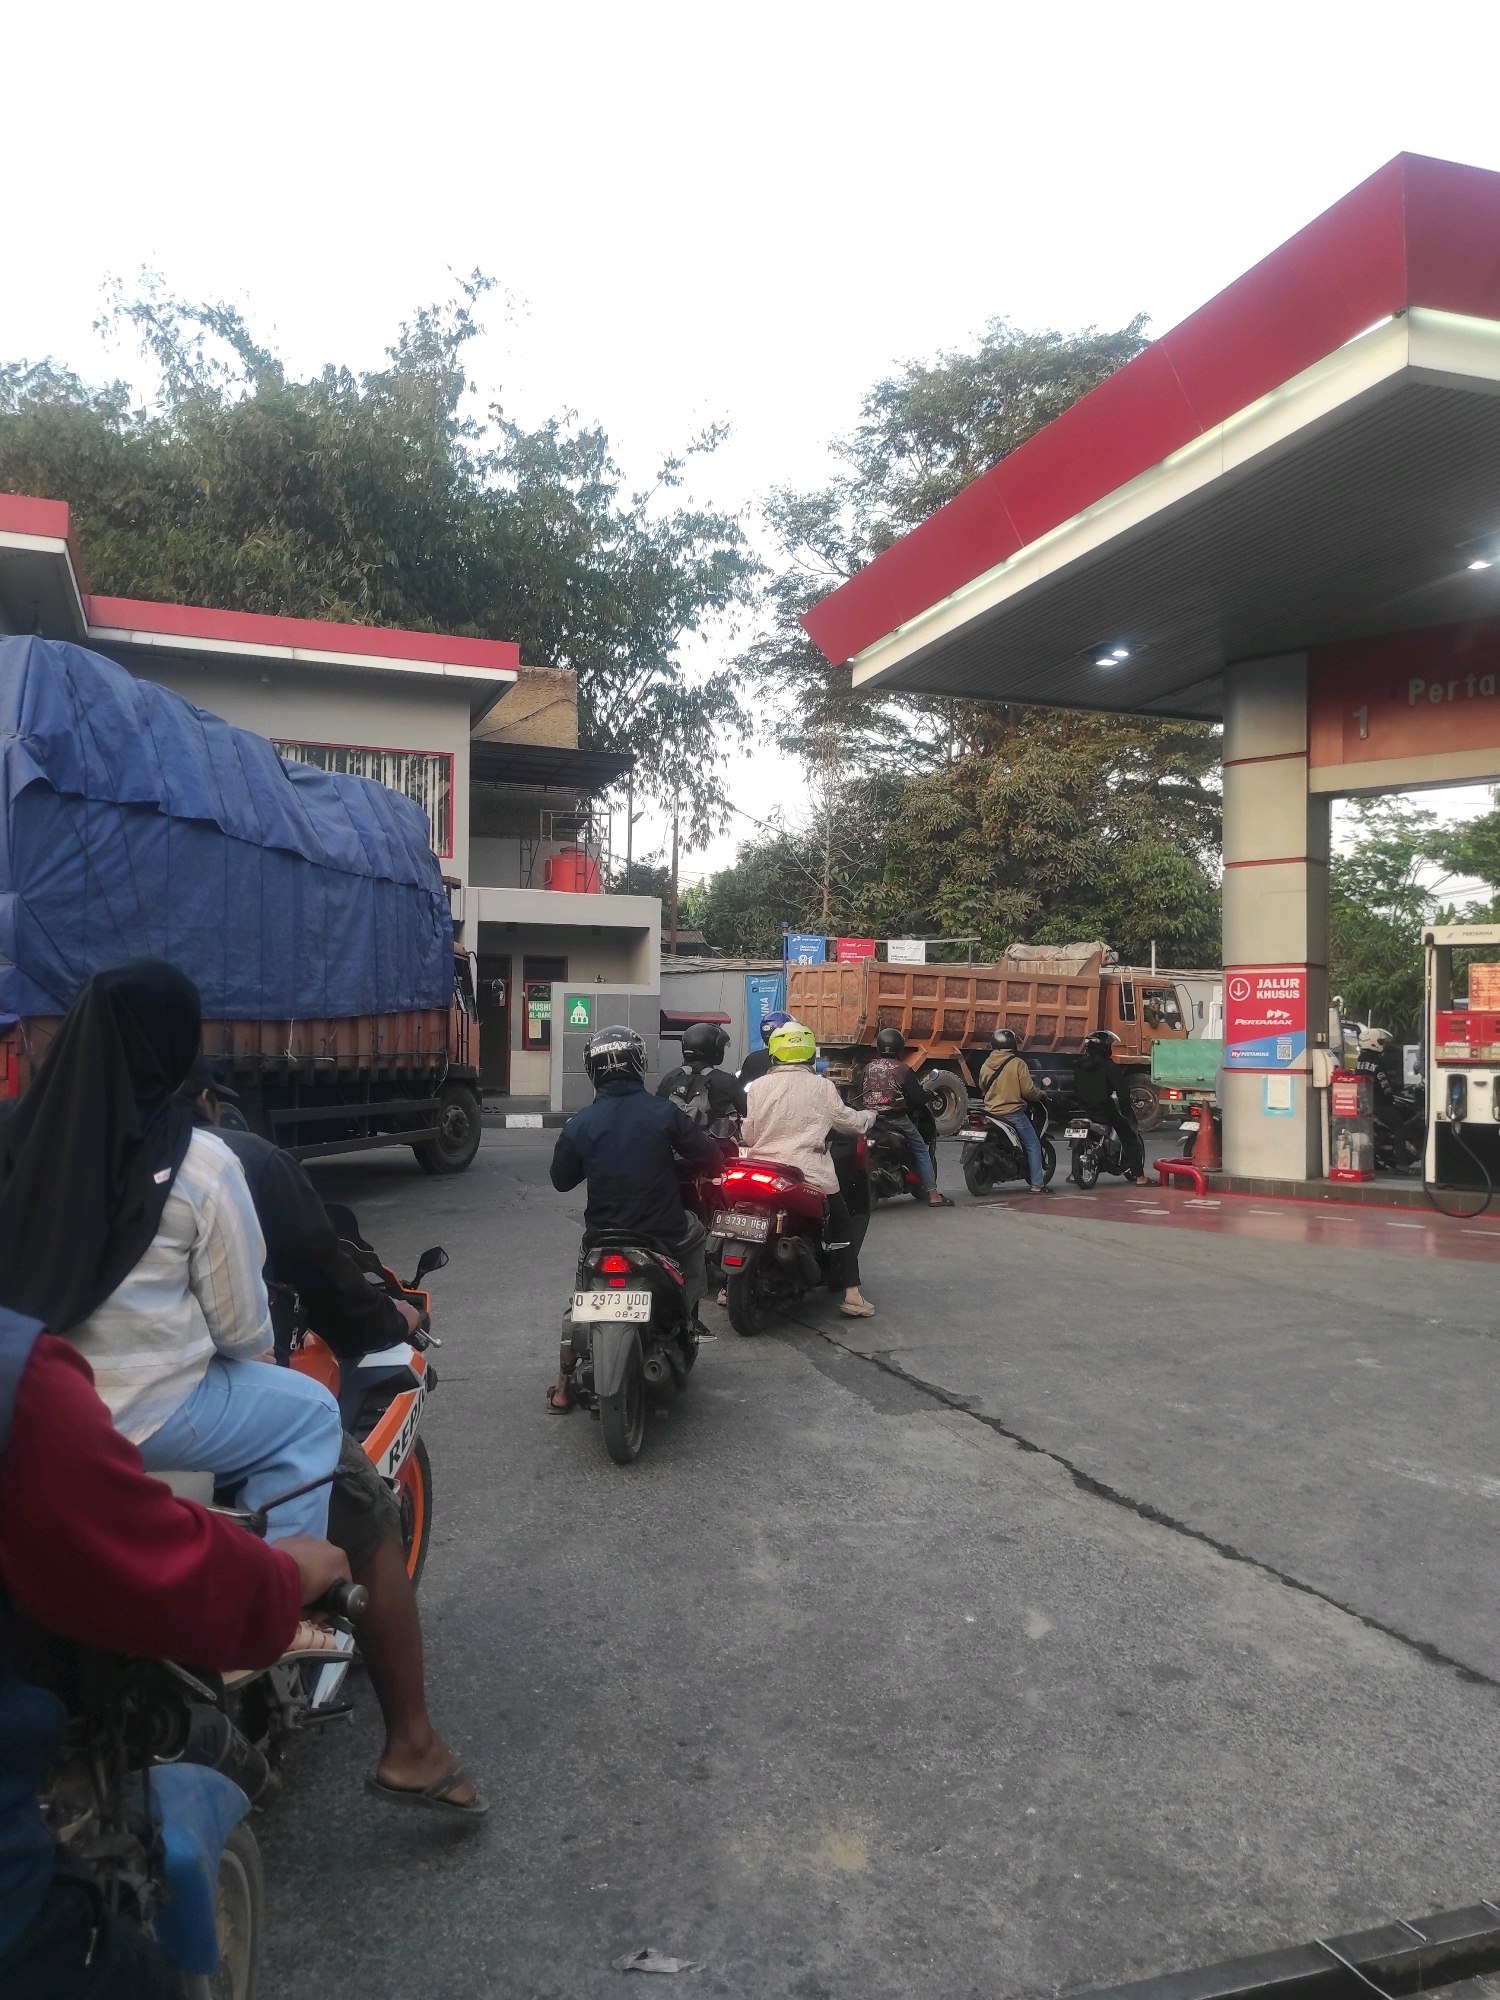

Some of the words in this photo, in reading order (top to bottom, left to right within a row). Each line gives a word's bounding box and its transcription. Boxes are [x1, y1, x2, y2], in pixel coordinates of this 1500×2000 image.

[1353, 704, 1369, 739] 1
[1257, 978, 1300, 989] JALUR
[1256, 990, 1300, 999] KHUSUS
[576, 1294, 583, 1306] D
[591, 1294, 621, 1306] 2973
[627, 1294, 649, 1306] UDD
